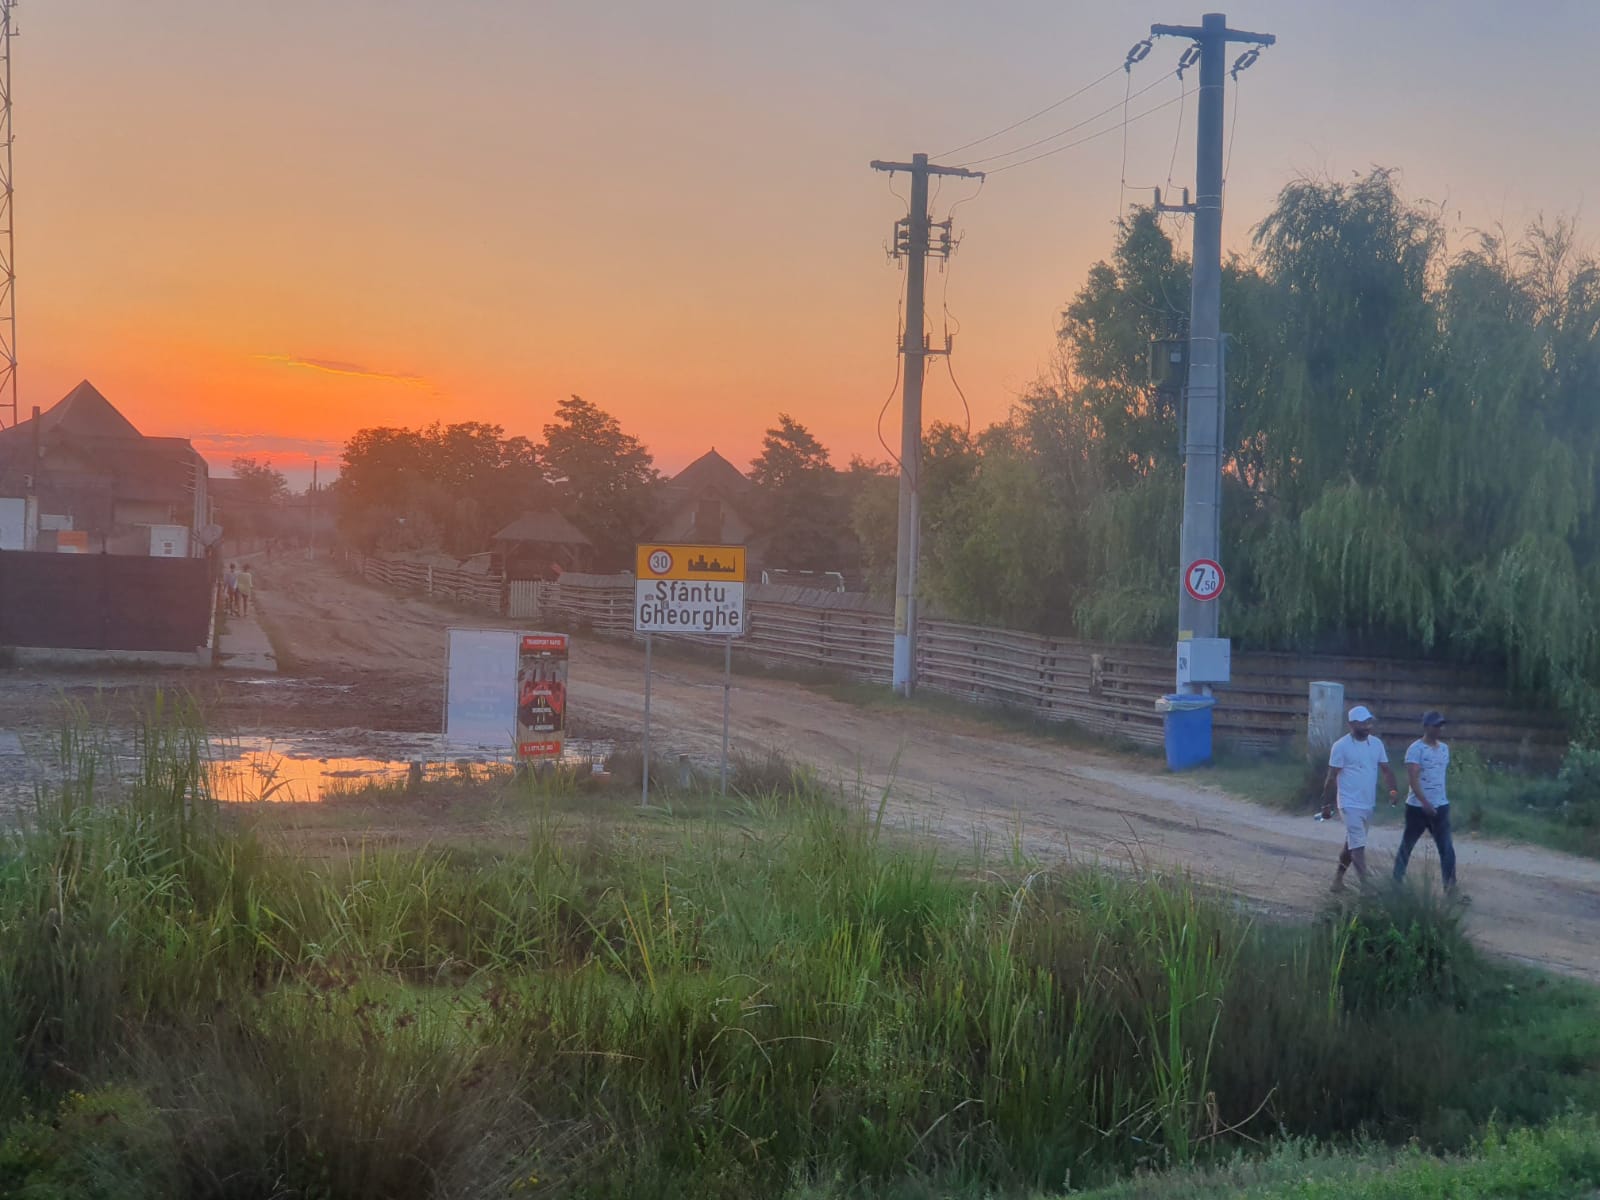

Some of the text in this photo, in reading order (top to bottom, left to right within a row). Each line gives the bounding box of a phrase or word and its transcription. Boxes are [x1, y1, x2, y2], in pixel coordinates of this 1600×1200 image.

[652, 555, 668, 569] 30
[655, 581, 725, 602] Sfântu
[640, 604, 739, 630] Gheorghe
